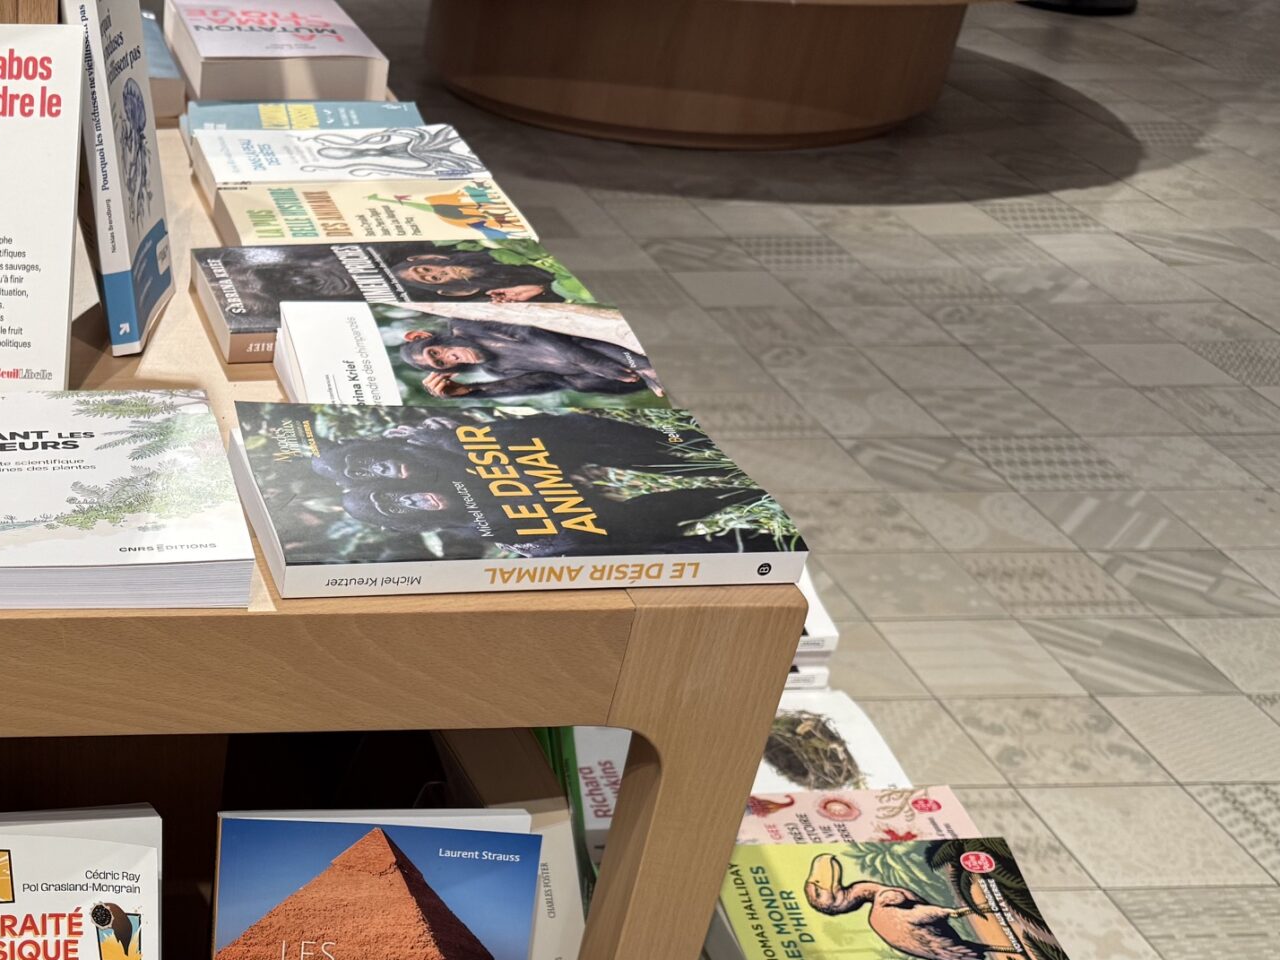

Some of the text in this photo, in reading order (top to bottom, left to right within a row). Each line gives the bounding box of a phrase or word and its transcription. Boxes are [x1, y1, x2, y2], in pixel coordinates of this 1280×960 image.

[40, 86, 61, 117] le
[91, 90, 102, 131] méduses
[96, 133, 104, 147] les
[96, 148, 109, 191] Pourquoi
[57, 431, 95, 439] LES
[456, 425, 558, 535] LE DÉSIR
[507, 437, 608, 536] ANIMAL
[325, 575, 421, 588] Michel Kreutzer
[439, 848, 520, 862] Laurent Strauss
[728, 863, 759, 921] HALLIDAY
[750, 866, 796, 938] MONDES
[782, 890, 816, 944] D'HIER
